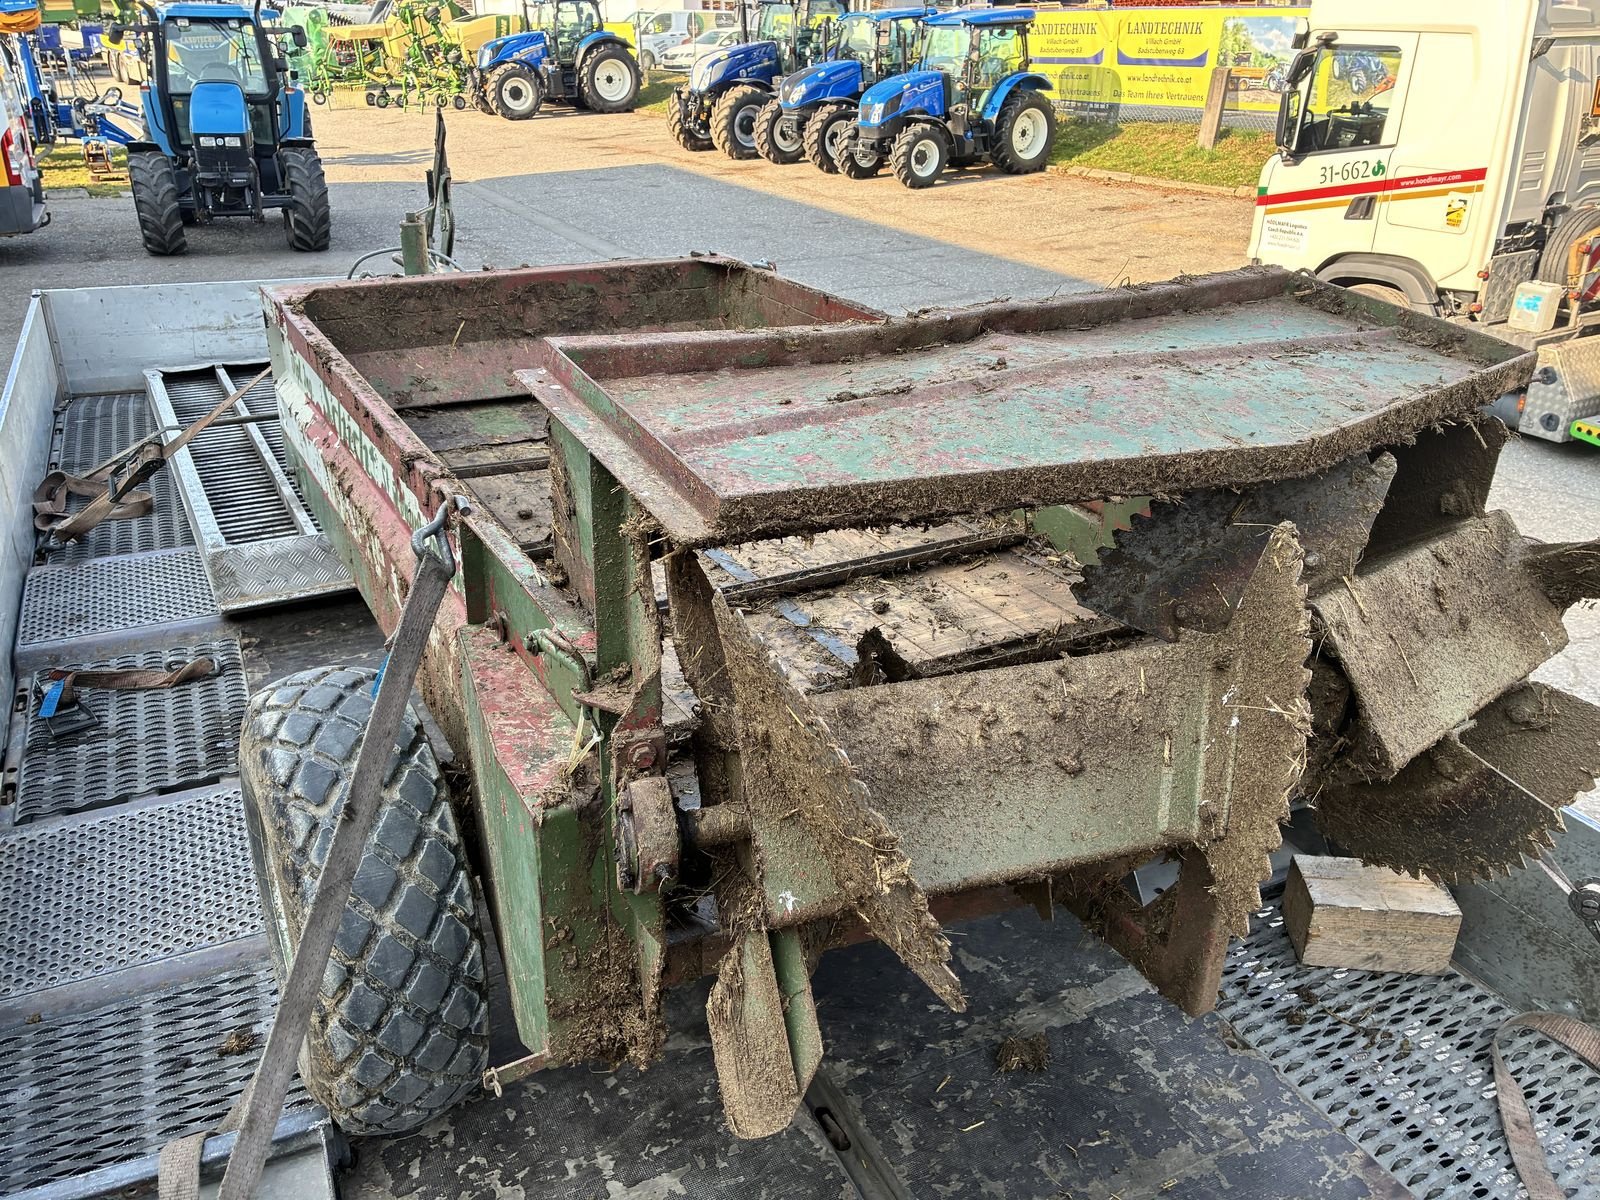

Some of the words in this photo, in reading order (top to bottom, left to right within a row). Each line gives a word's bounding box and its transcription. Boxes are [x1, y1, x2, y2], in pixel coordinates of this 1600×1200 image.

[1127, 22, 1203, 34] LANDTECHNIK
[1127, 73, 1192, 83] www.landtechnik.co.at
[1067, 89, 1100, 97] Vertrauens
[1113, 89, 1125, 97] Das
[1128, 90, 1144, 98] Team
[1146, 90, 1164, 99] Ihres
[1166, 91, 1204, 101] Vertrauens
[1320, 160, 1370, 184] 31-662
[1400, 173, 1462, 186] www.hoedlmayr.com
